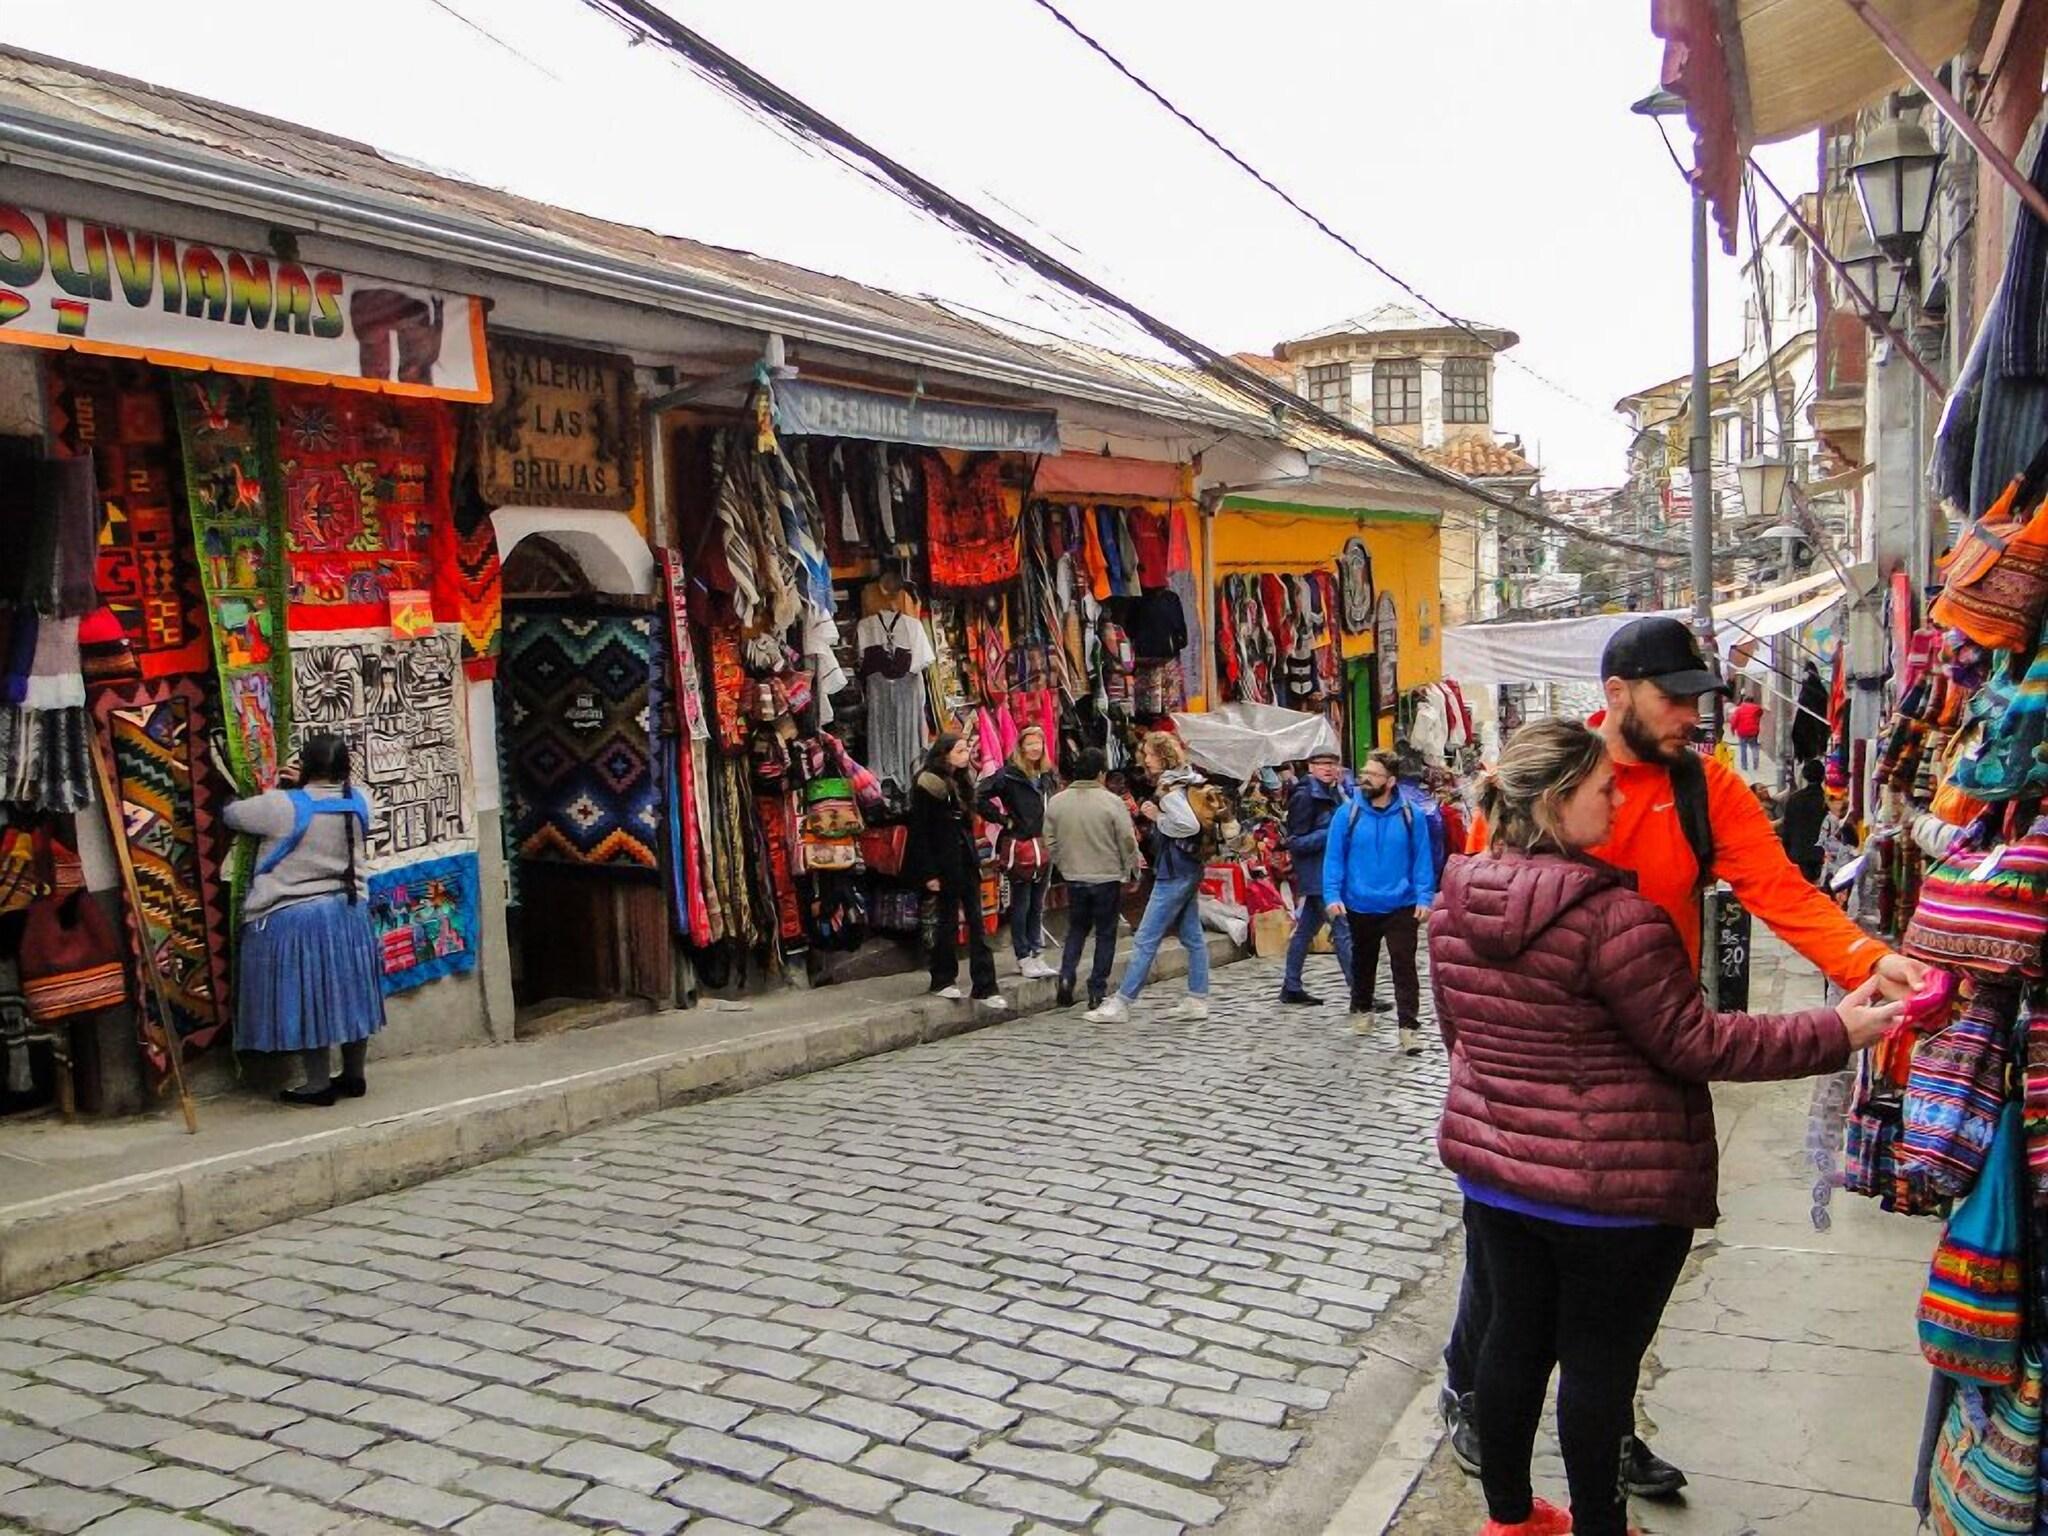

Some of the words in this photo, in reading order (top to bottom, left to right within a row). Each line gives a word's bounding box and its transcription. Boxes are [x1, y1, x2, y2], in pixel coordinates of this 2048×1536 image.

[502, 353, 605, 393] GALERIA
[535, 403, 583, 438] LAS
[512, 458, 607, 494] BRUJAS
[1722, 946, 1744, 964] 20
